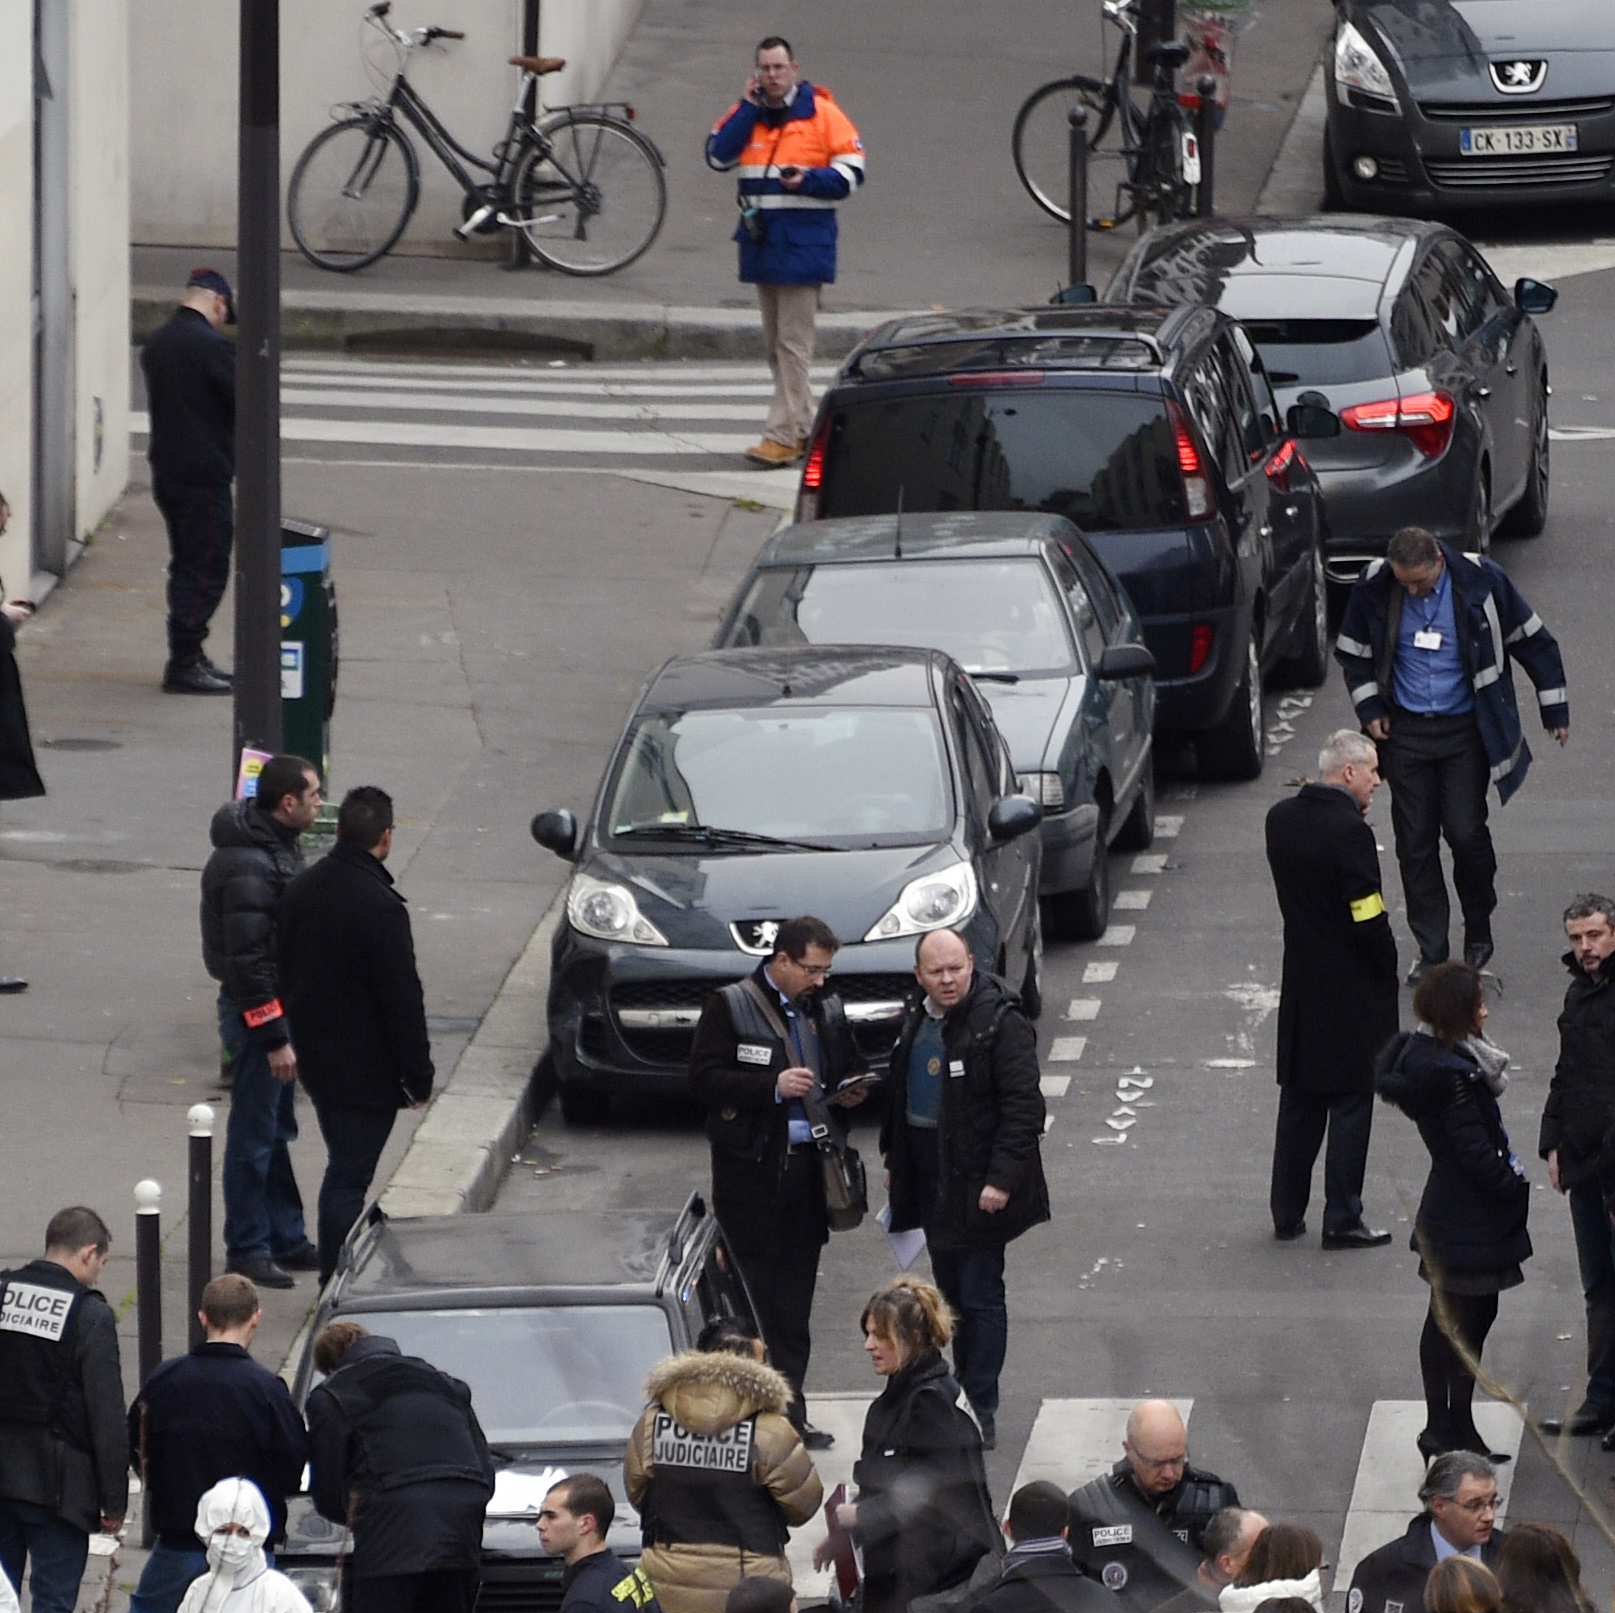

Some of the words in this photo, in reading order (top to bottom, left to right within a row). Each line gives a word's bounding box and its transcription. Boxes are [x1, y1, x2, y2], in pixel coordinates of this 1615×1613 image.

[1473, 132, 1563, 152] CK-133-SX
[738, 1046, 770, 1058] POLICE
[654, 1442, 746, 1469] JUDICIAIRE
[1094, 1526, 1131, 1539] POLICE
